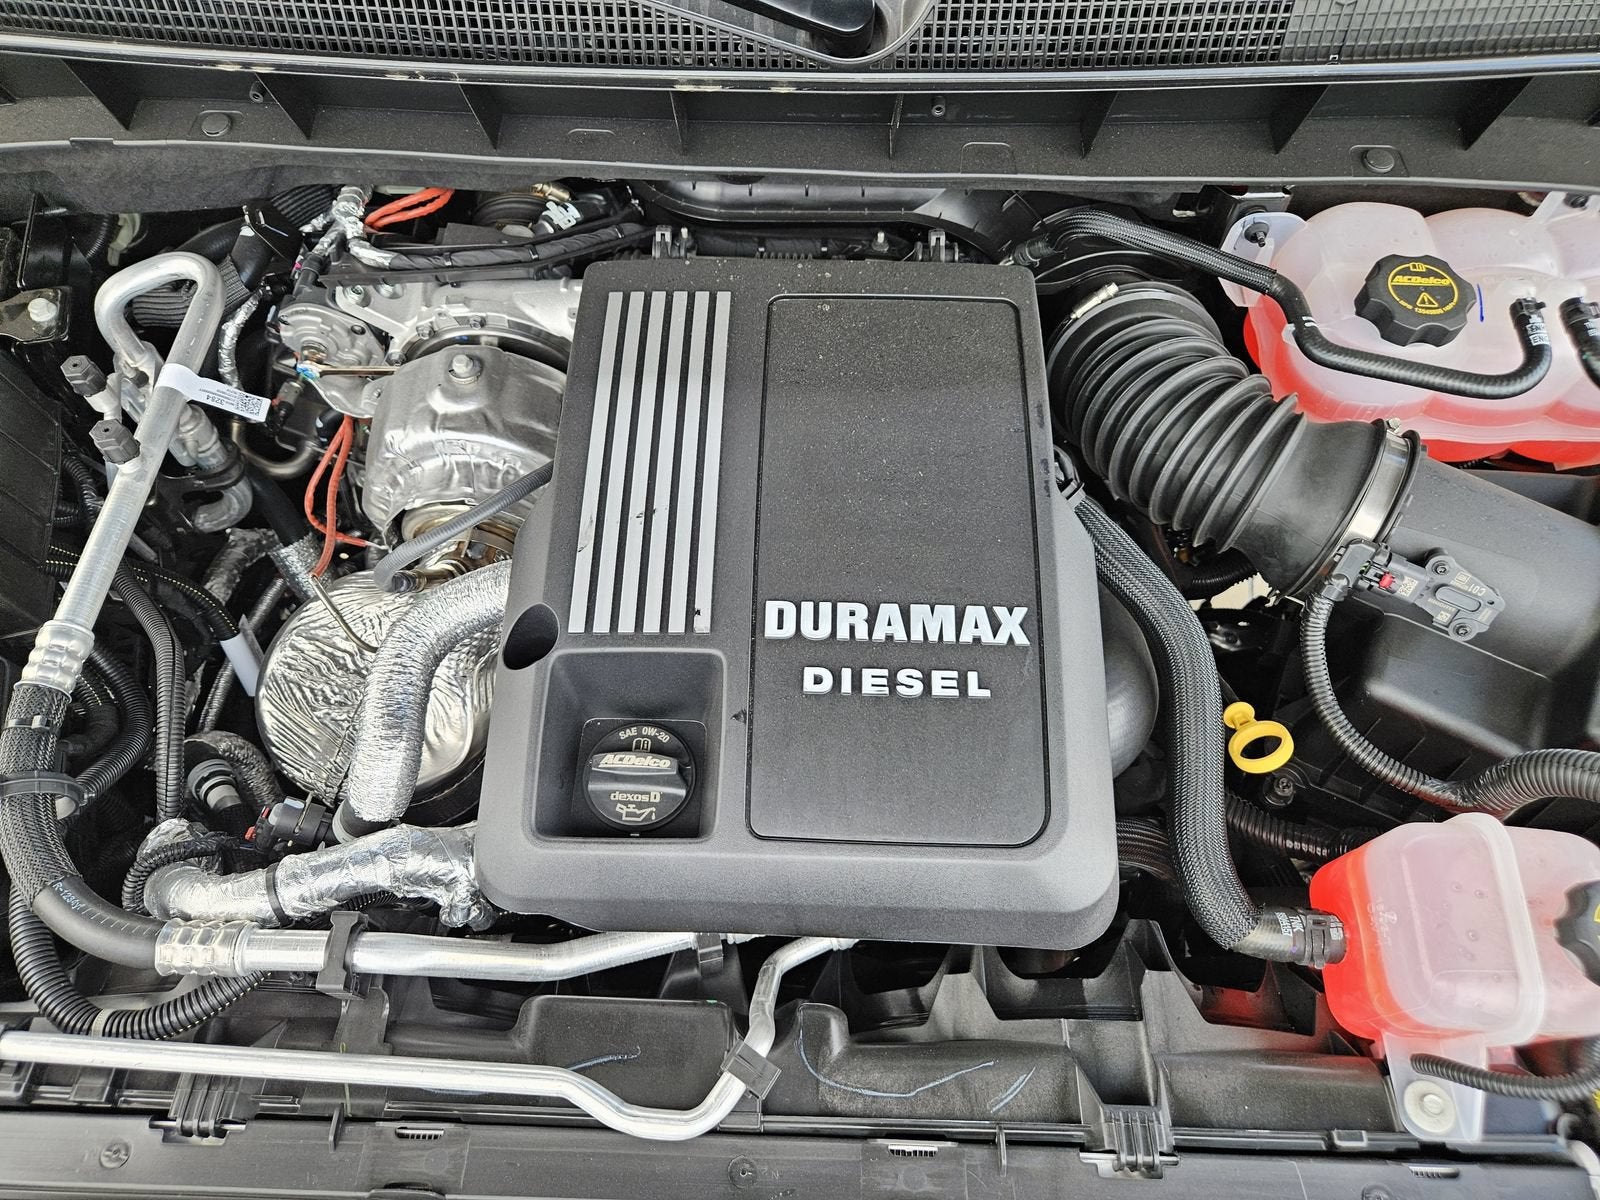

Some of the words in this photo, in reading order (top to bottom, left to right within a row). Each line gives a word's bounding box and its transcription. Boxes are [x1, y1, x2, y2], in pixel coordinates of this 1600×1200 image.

[1392, 275, 1451, 286] ACDelco
[764, 600, 1030, 646] DURAMAX
[803, 666, 991, 698] DIESEL
[619, 727, 637, 740] SAE
[642, 727, 670, 743] 0W-20
[598, 754, 672, 769] ACDelco
